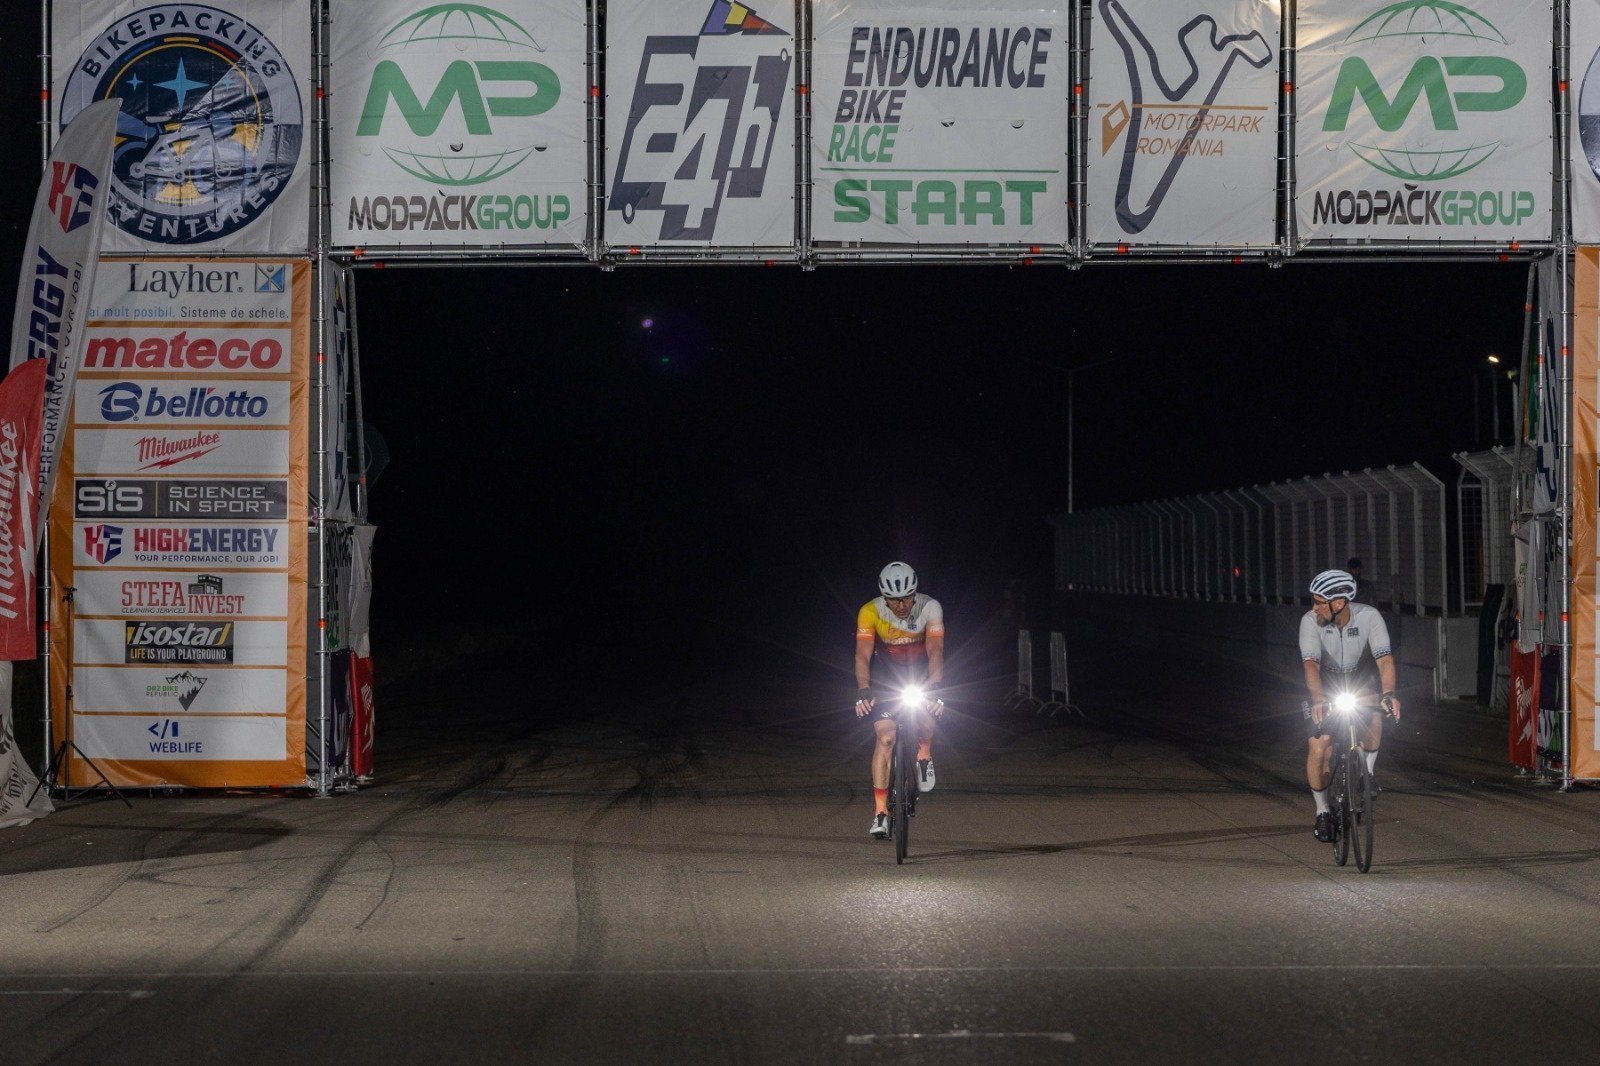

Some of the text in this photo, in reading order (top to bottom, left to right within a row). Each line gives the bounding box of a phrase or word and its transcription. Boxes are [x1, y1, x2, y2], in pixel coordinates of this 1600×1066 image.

[82, 11, 281, 78] BIKEPACKING
[844, 26, 1052, 88] ENDURANCE
[356, 60, 561, 137] MP
[834, 89, 907, 124] BIKE
[1321, 55, 1527, 132] MP
[1143, 112, 1265, 133] MOTORPARK
[827, 124, 899, 163] RACE
[1135, 134, 1224, 157] ROMÂNIA
[834, 178, 1047, 226] START
[104, 306, 130, 318] mult
[134, 306, 176, 323] posibil.
[180, 306, 227, 319] Sisteme
[231, 306, 245, 319] de
[248, 306, 290, 319] schele.
[84, 331, 283, 370] mateco
[144, 387, 269, 418] bellotto
[134, 431, 220, 463] Milwaukee
[169, 486, 266, 499] SCIENCE
[169, 500, 275, 513] IN SPORT
[134, 554, 279, 564] YOUR PERFORMANCE, OUR JOB!
[121, 581, 186, 607] STEFA
[187, 595, 245, 614] INVEST
[132, 622, 224, 646] isostar
[130, 648, 227, 660] LIFE IS YOUR PLAYGROUND
[149, 742, 203, 753] WEBLIFE
